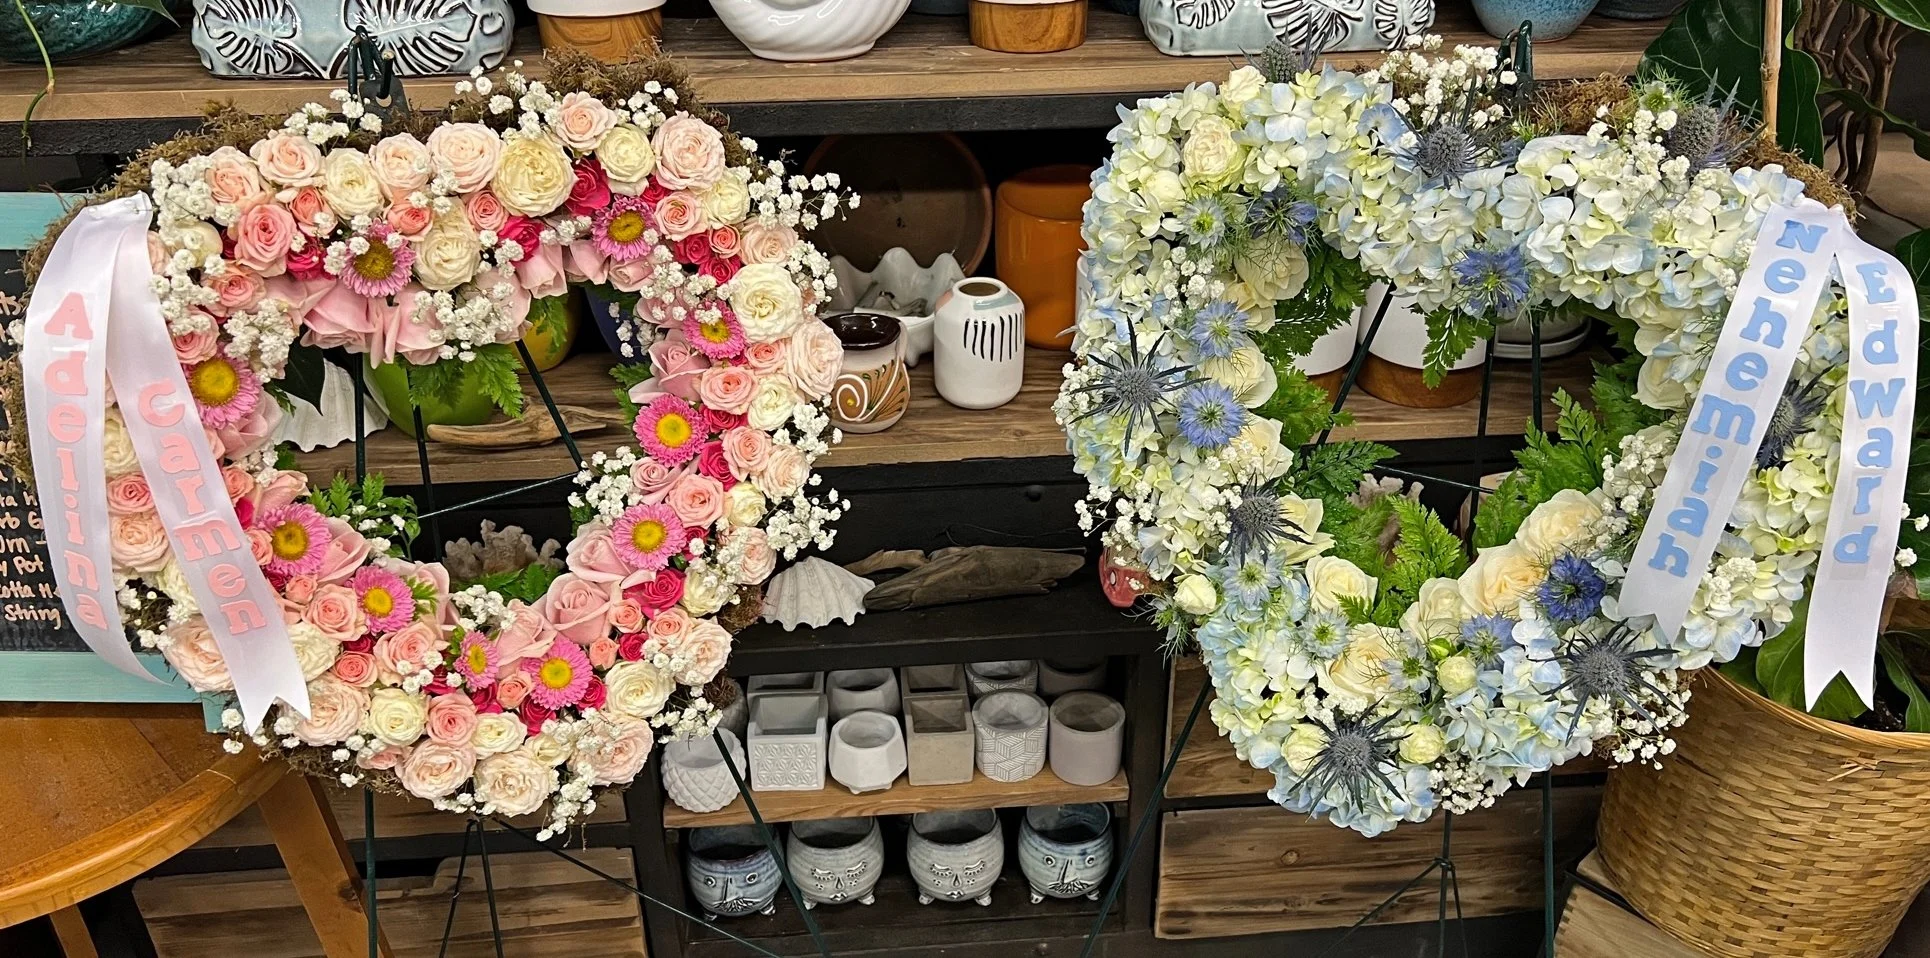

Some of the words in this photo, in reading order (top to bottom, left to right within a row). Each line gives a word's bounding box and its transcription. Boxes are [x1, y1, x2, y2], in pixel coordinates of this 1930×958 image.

[44, 291, 109, 631] Adelina
[138, 378, 268, 637] Carmen
[1648, 219, 1829, 579] Nehemiah
[1833, 261, 1906, 565] Edward
[4, 603, 62, 631] String
[12, 554, 45, 575] Pot
